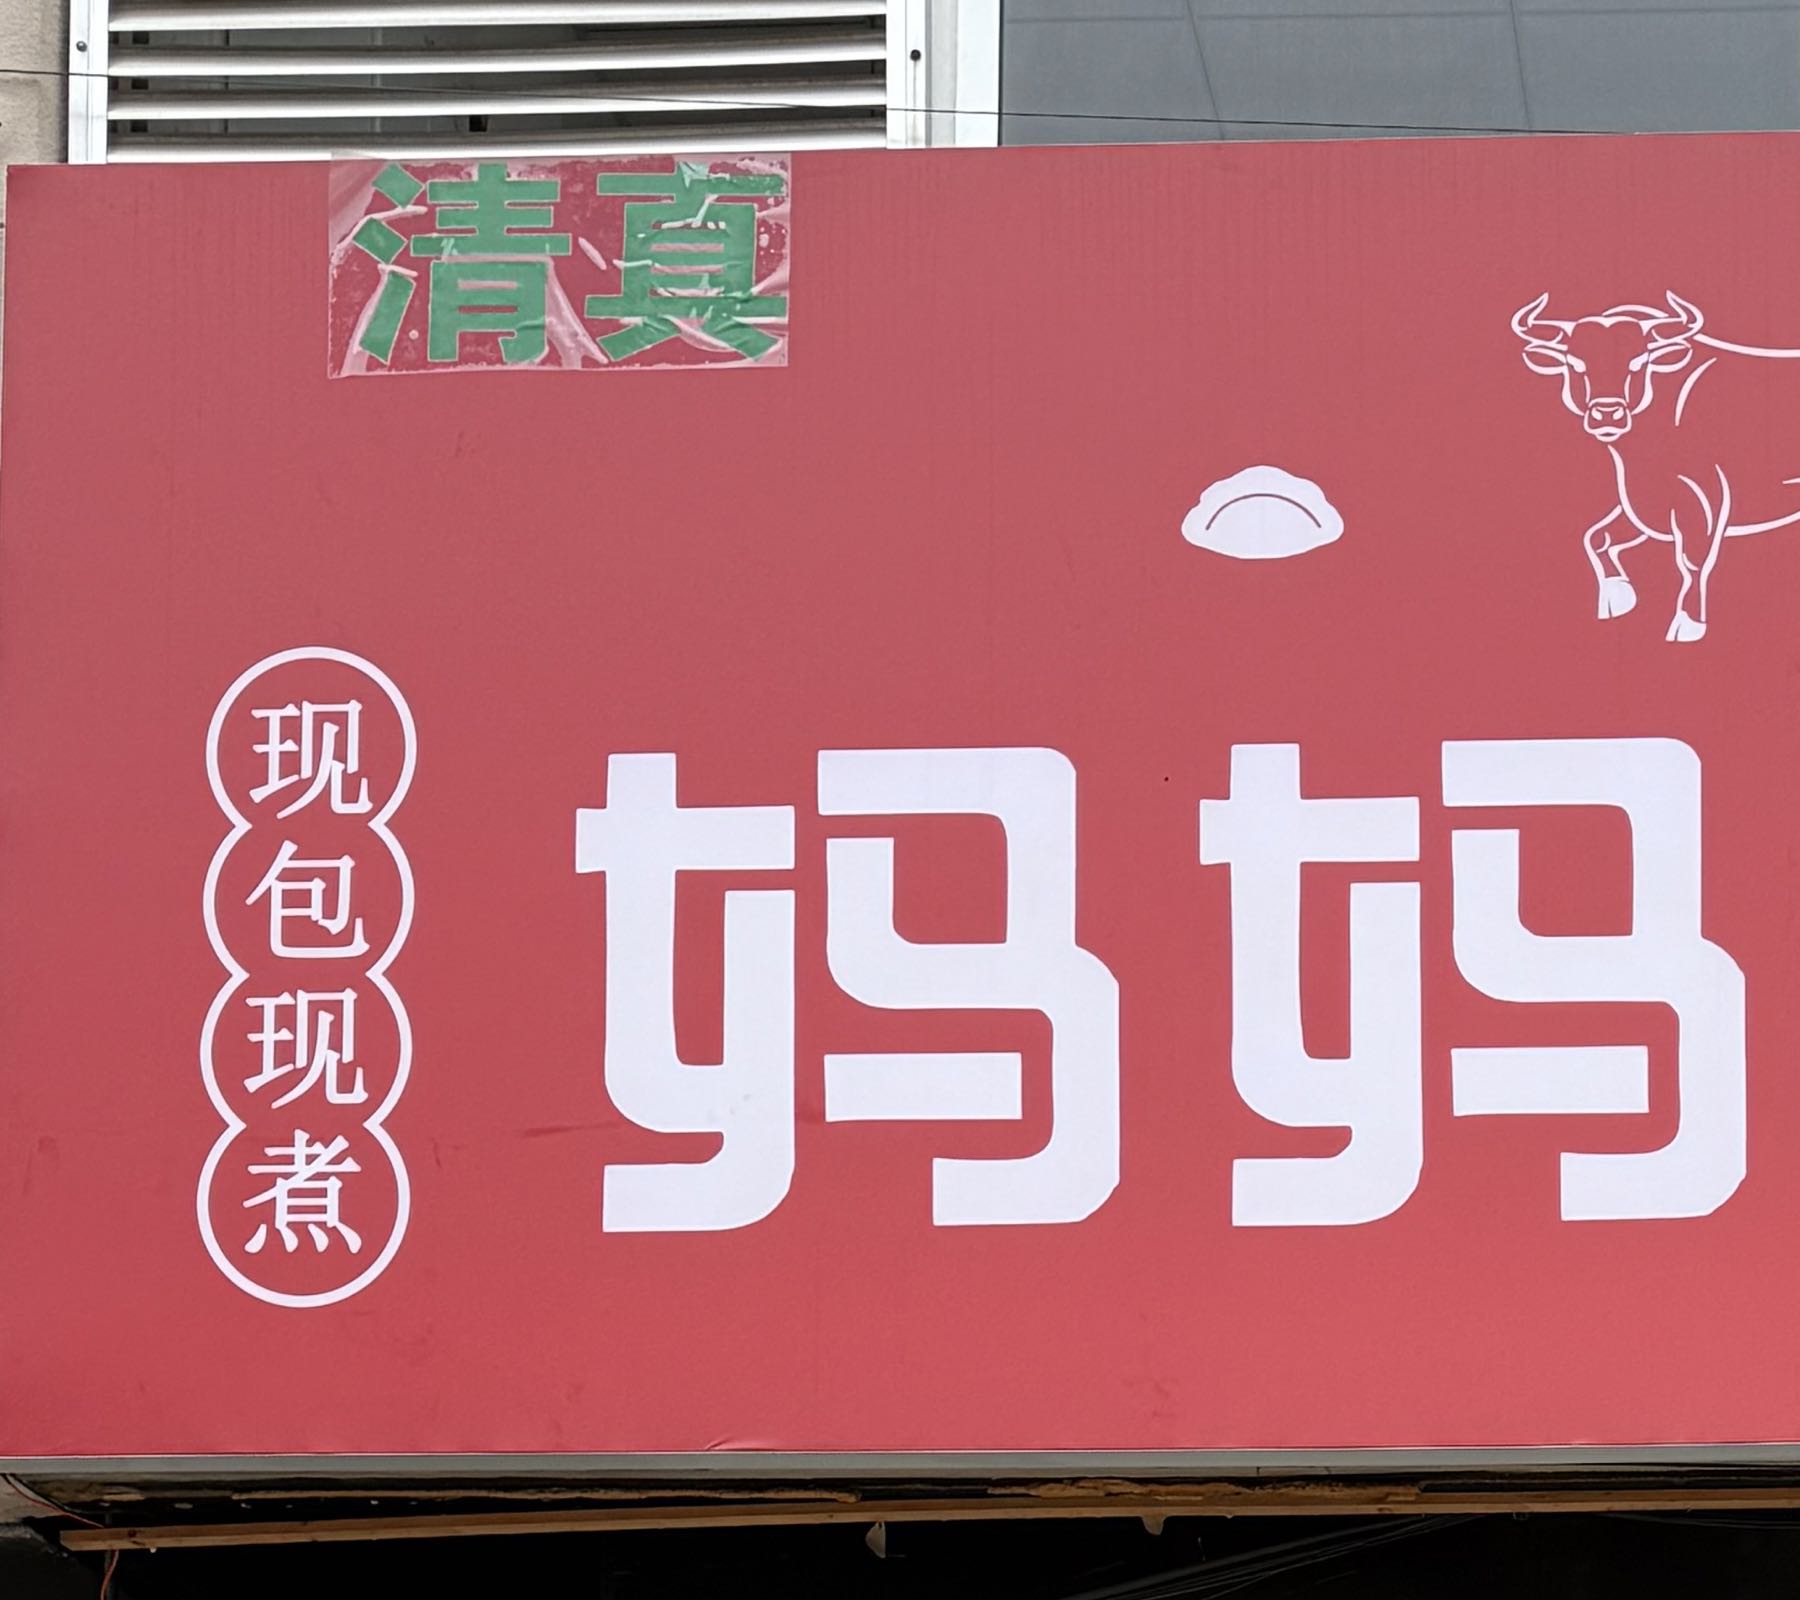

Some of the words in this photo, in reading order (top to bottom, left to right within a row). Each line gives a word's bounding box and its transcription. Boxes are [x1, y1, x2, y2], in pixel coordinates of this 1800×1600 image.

[355, 164, 787, 363] 清真
[243, 699, 374, 1254] 现包现煮
